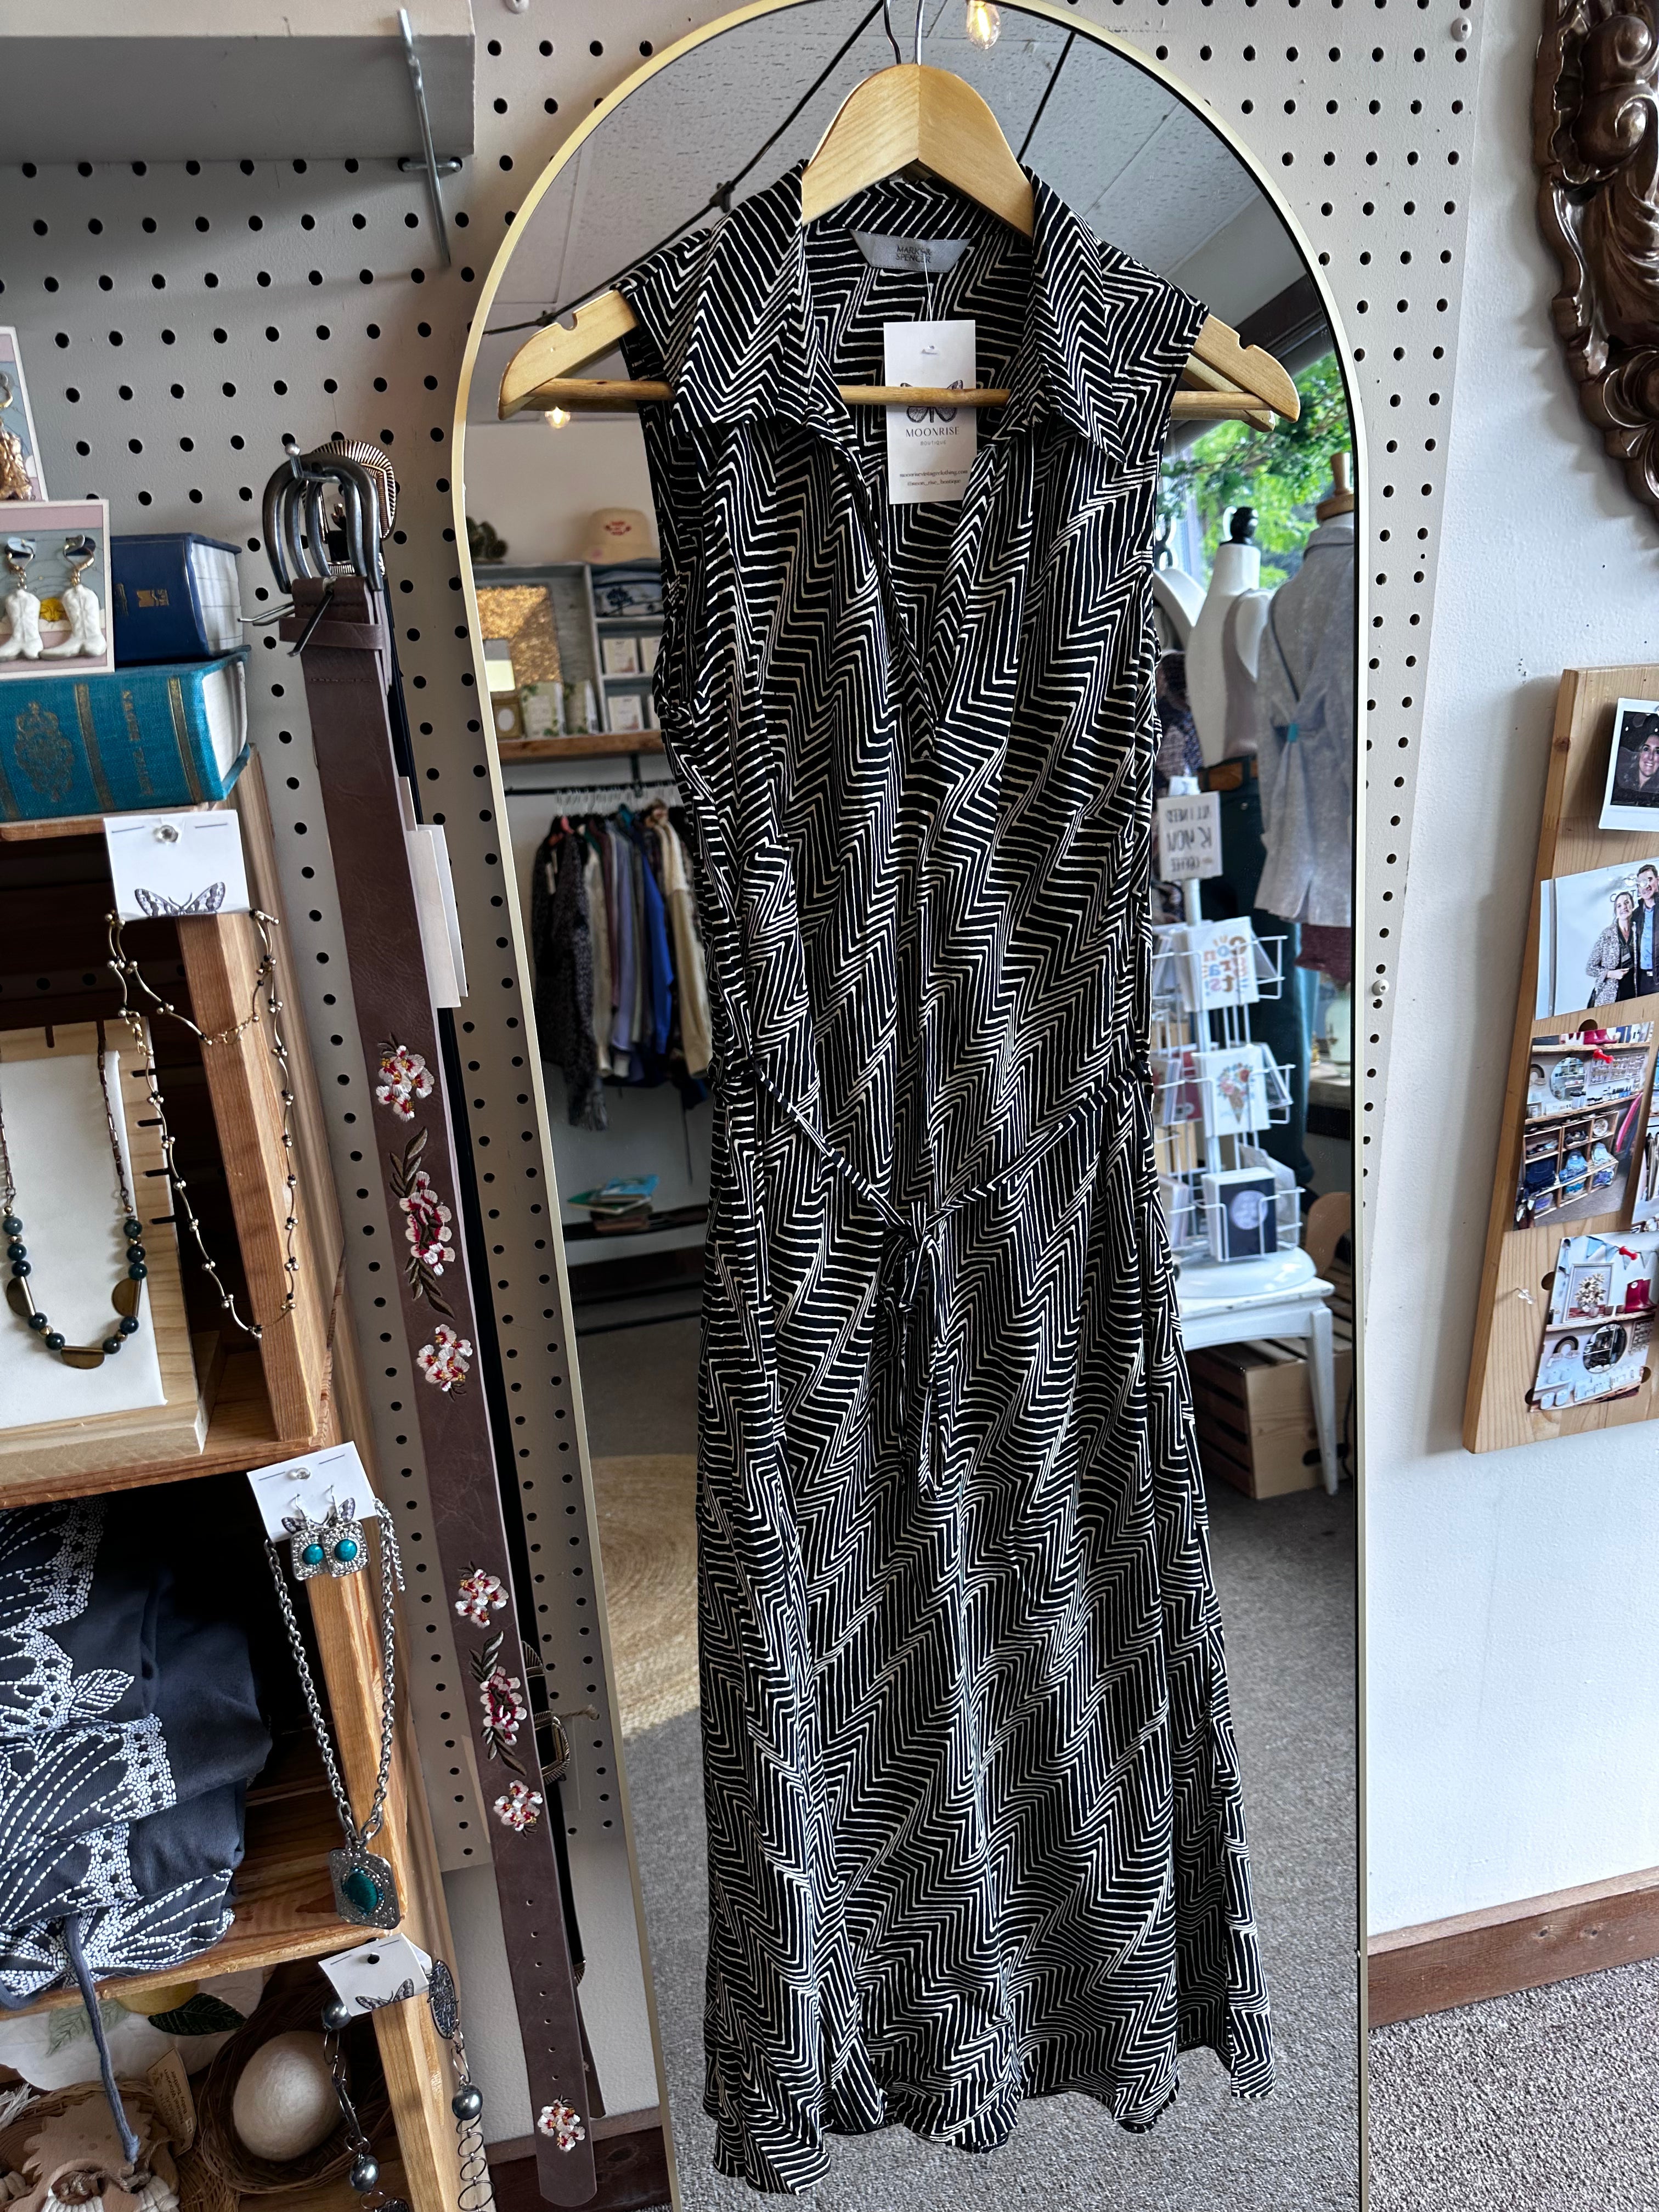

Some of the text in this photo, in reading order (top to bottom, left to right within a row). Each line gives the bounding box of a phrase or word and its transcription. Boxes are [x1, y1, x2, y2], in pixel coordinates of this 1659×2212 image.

[906, 426, 960, 438] MOONRISE
[164, 2069, 184, 2125] Natural Wooden
